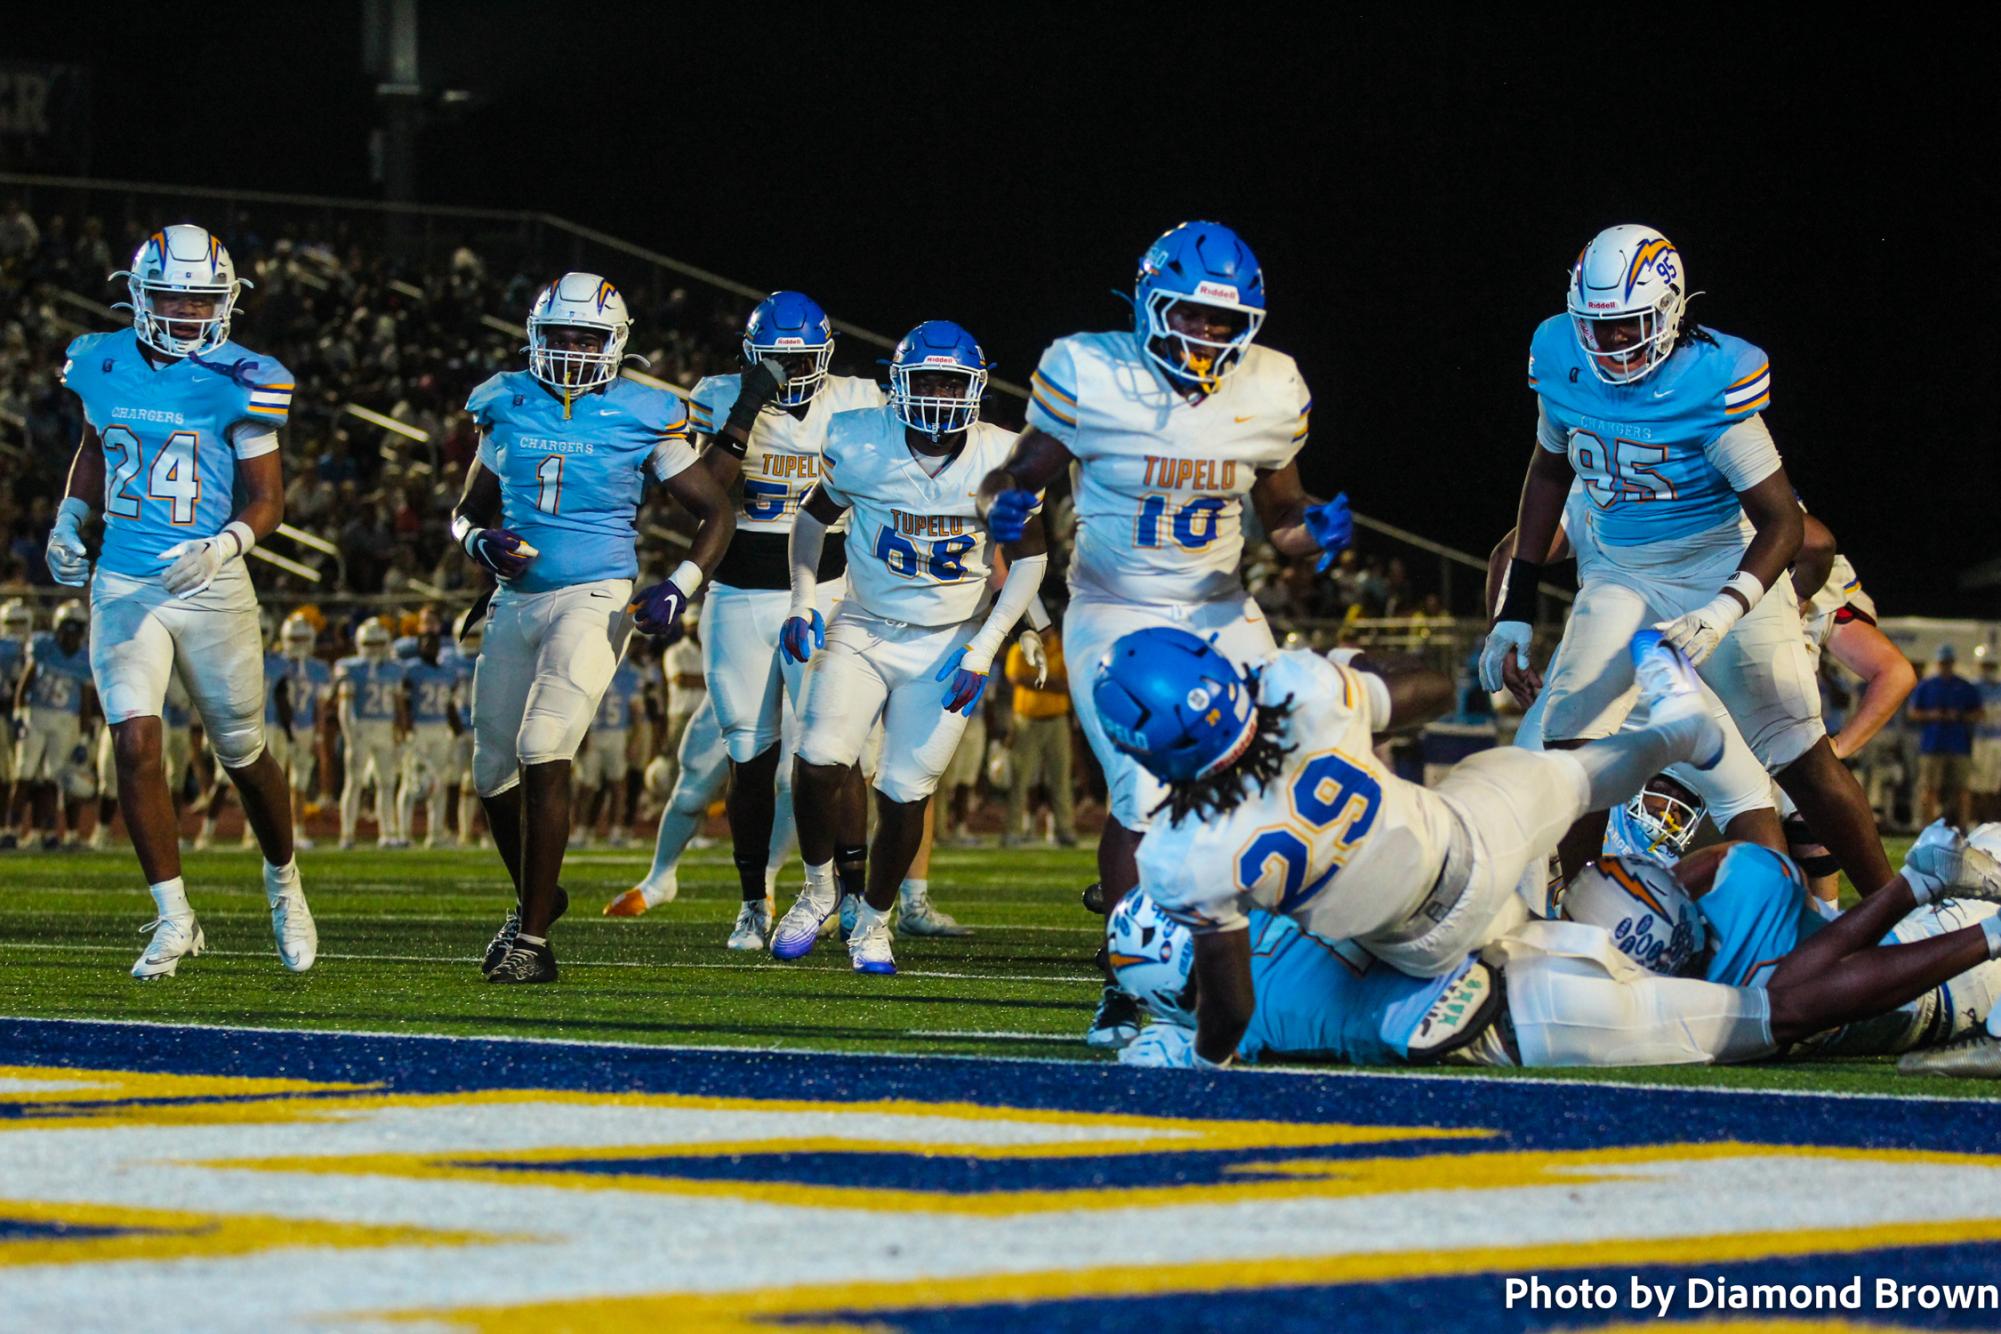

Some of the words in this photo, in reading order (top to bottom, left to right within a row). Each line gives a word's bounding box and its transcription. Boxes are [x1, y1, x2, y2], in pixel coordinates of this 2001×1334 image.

[1656, 256, 1677, 284] 95
[1200, 285, 1236, 300] Riddell
[1588, 301, 1616, 309] Riddell
[111, 406, 185, 425] CHARGERS
[1581, 415, 1652, 440] CHARGERS
[519, 436, 595, 455] CHARGERS
[101, 424, 201, 527] 24
[762, 454, 822, 479] TUPEL
[1143, 455, 1236, 490] TUPELO
[1567, 428, 1679, 511] 95
[536, 453, 565, 516] 1
[891, 508, 963, 537] TUPELO
[872, 522, 979, 585] 68
[1233, 748, 1386, 914] 29
